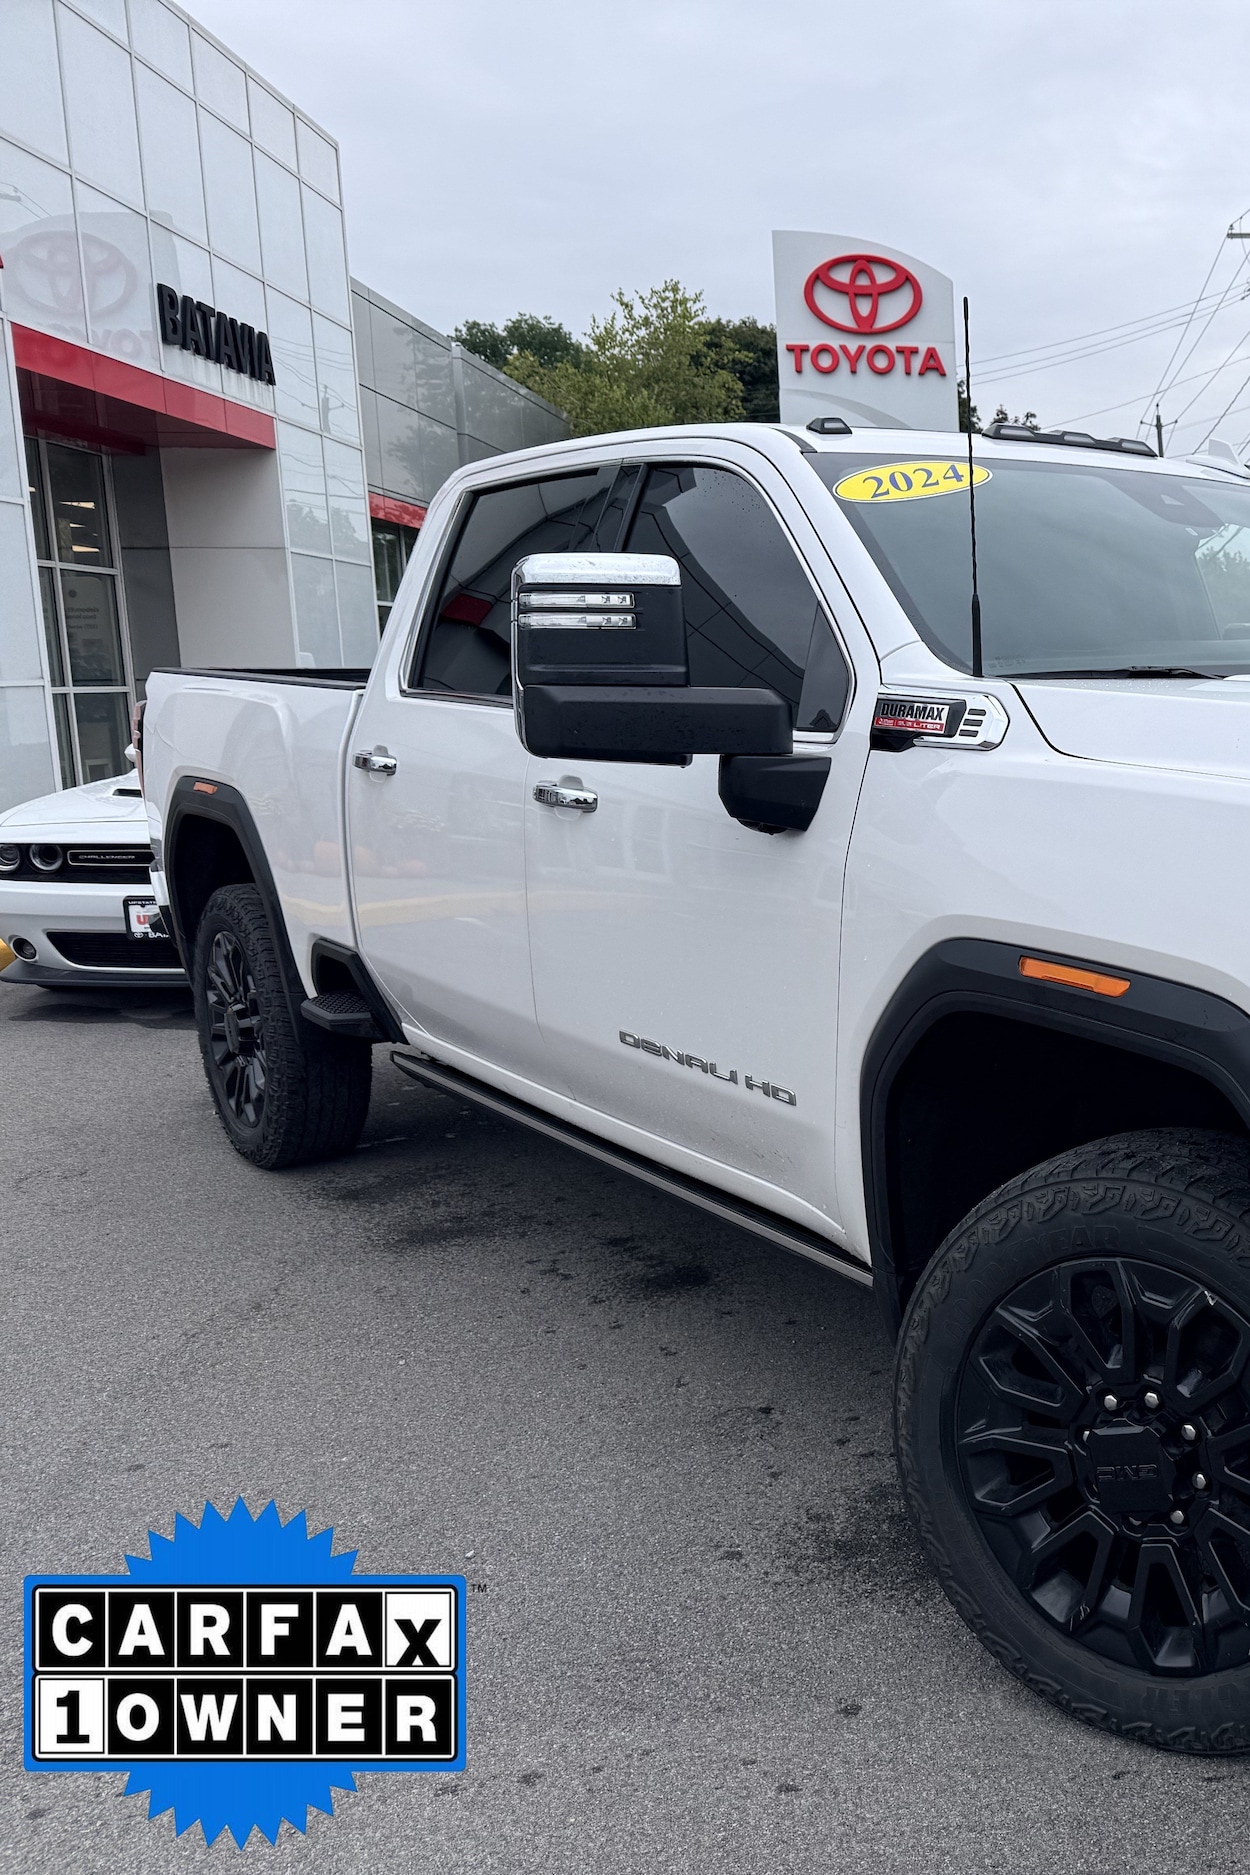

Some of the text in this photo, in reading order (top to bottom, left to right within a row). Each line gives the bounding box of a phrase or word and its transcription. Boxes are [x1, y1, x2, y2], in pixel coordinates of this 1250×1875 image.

[157, 283, 276, 386] BATAVIA
[786, 343, 947, 376] TOYOTA
[863, 464, 965, 499] 2024
[881, 703, 946, 721] DURAMAX
[913, 722, 941, 730] LITER
[619, 1029, 797, 1106] DENALI HD
[1097, 1464, 1158, 1481] GMC
